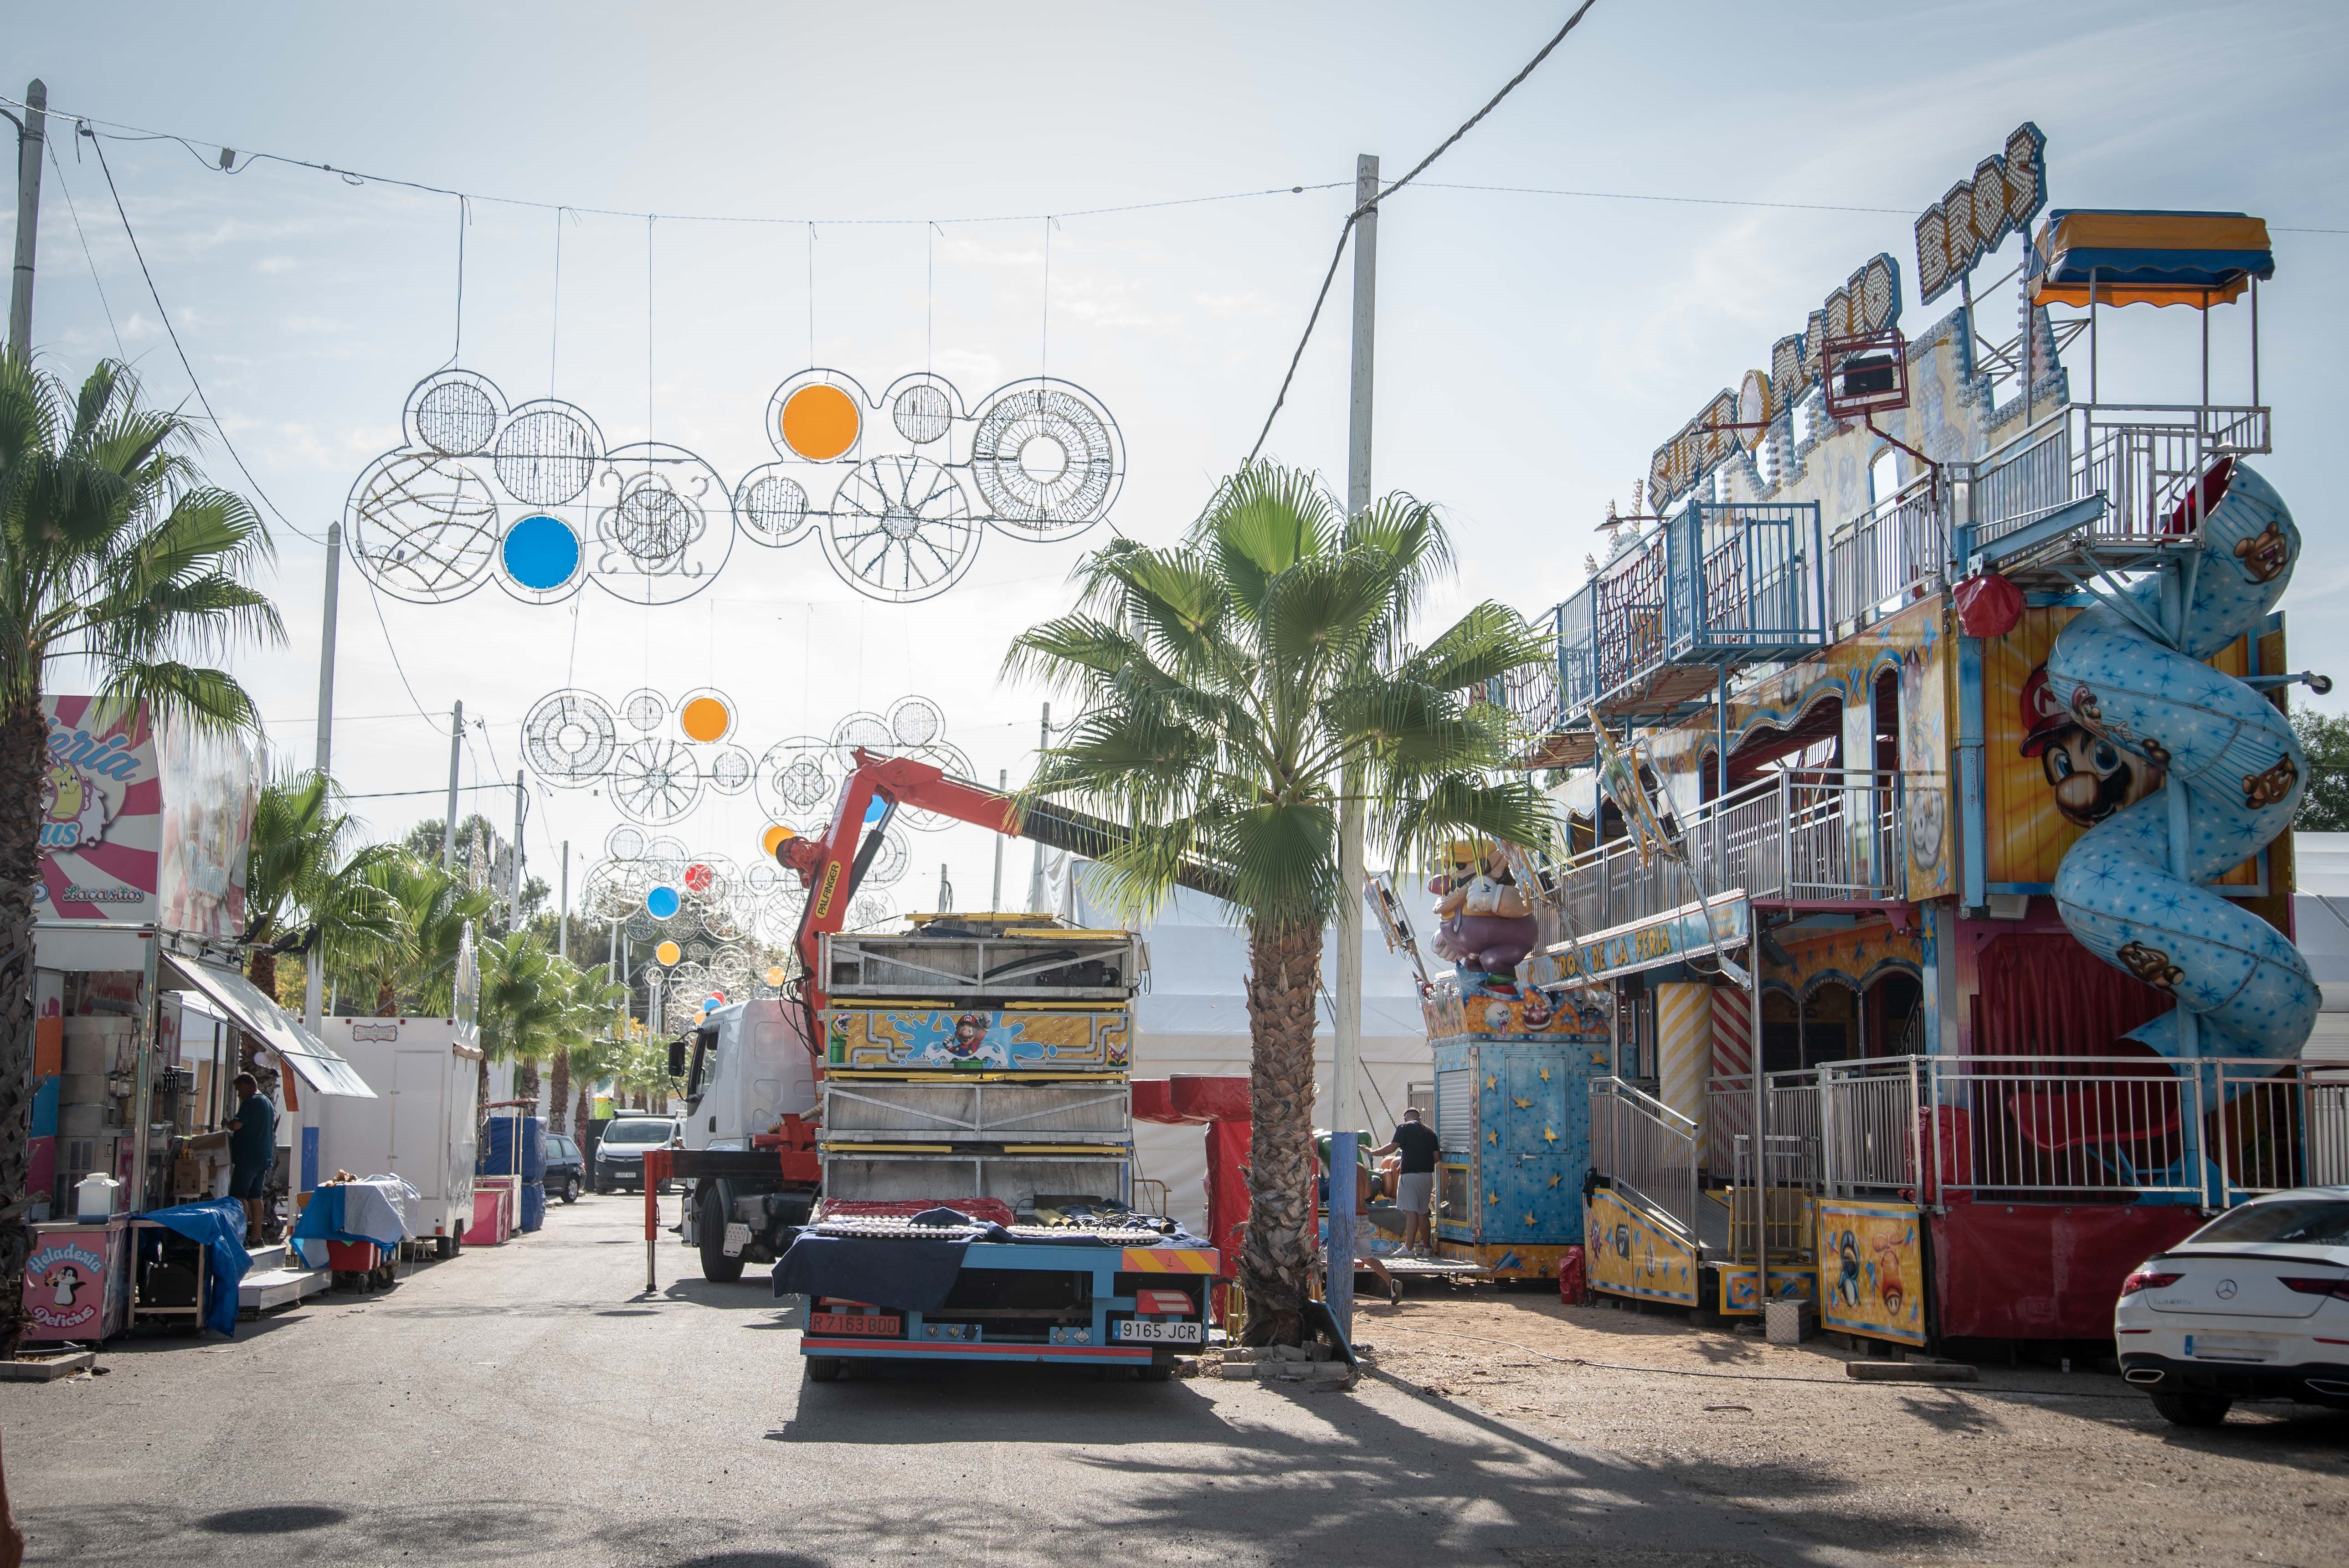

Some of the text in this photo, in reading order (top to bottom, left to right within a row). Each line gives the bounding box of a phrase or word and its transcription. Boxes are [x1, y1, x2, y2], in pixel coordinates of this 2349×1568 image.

[1649, 129, 2038, 513] SUPER MARIO BROS
[62, 883, 144, 903] Lacasitos
[817, 864, 839, 915] PALFINGER
[1591, 942, 1607, 972] DE
[1612, 938, 1631, 967] LA
[1635, 925, 1672, 962] FERIA
[29, 1243, 103, 1274] Heladería
[813, 1316, 896, 1333] R 7163 BDD
[1123, 1323, 1196, 1339] 9165 JCR
